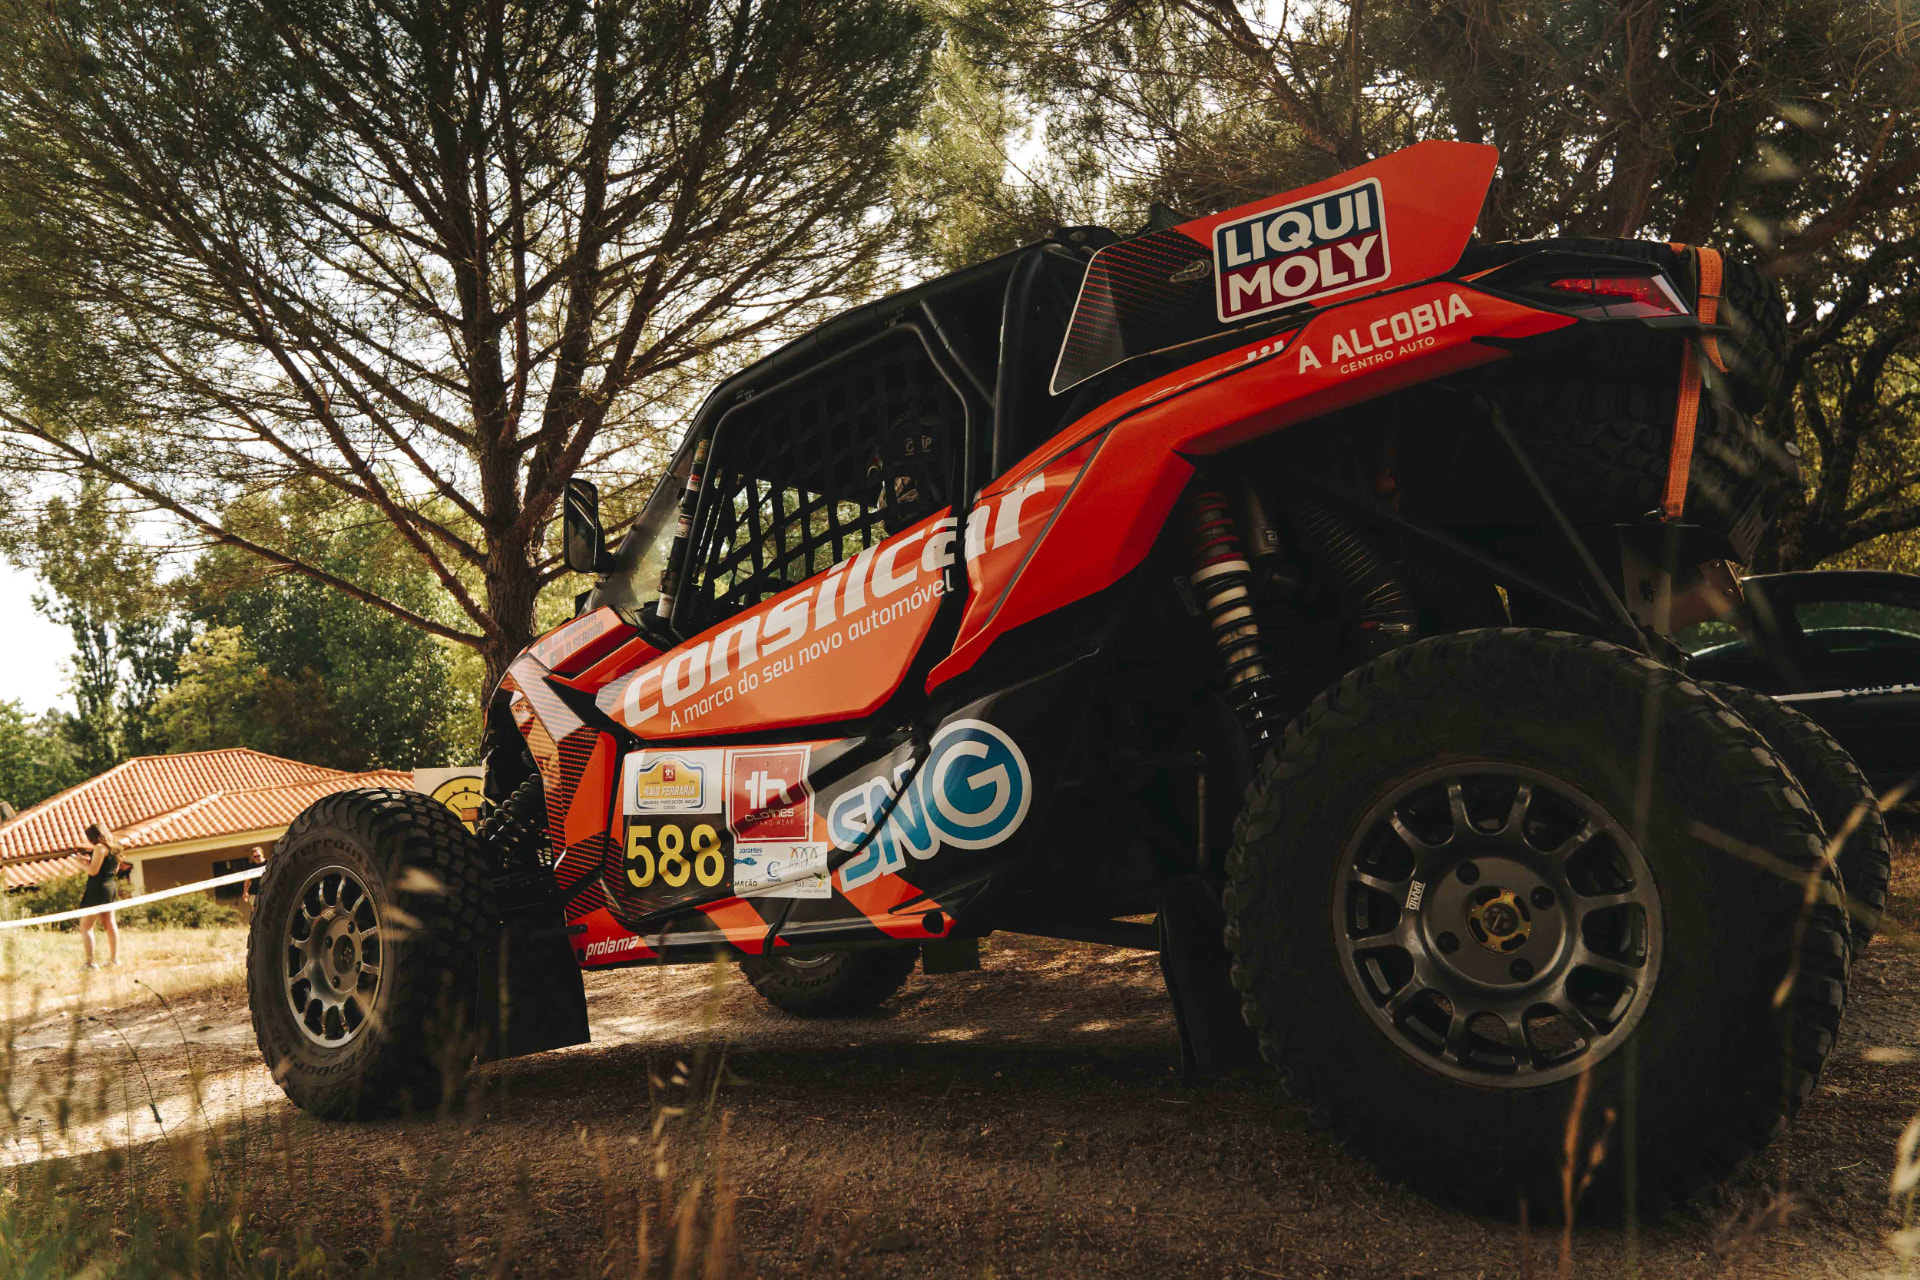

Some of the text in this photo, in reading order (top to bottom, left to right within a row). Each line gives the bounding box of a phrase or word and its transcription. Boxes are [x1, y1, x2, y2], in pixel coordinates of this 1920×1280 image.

[1225, 190, 1371, 267] LIQUI
[1228, 234, 1379, 312] MOLY
[1299, 345, 1322, 375] A
[1331, 293, 1473, 364] ALCOBIA
[1340, 336, 1435, 374] CENTRO AUTO
[624, 473, 1046, 727] consilcar
[670, 570, 955, 732] A marca do seu novo automóvel
[745, 770, 792, 810] th
[829, 720, 1031, 891] SNG
[627, 824, 725, 888] 588
[1408, 880, 1424, 910] BRAID
[585, 935, 640, 961] prolama
